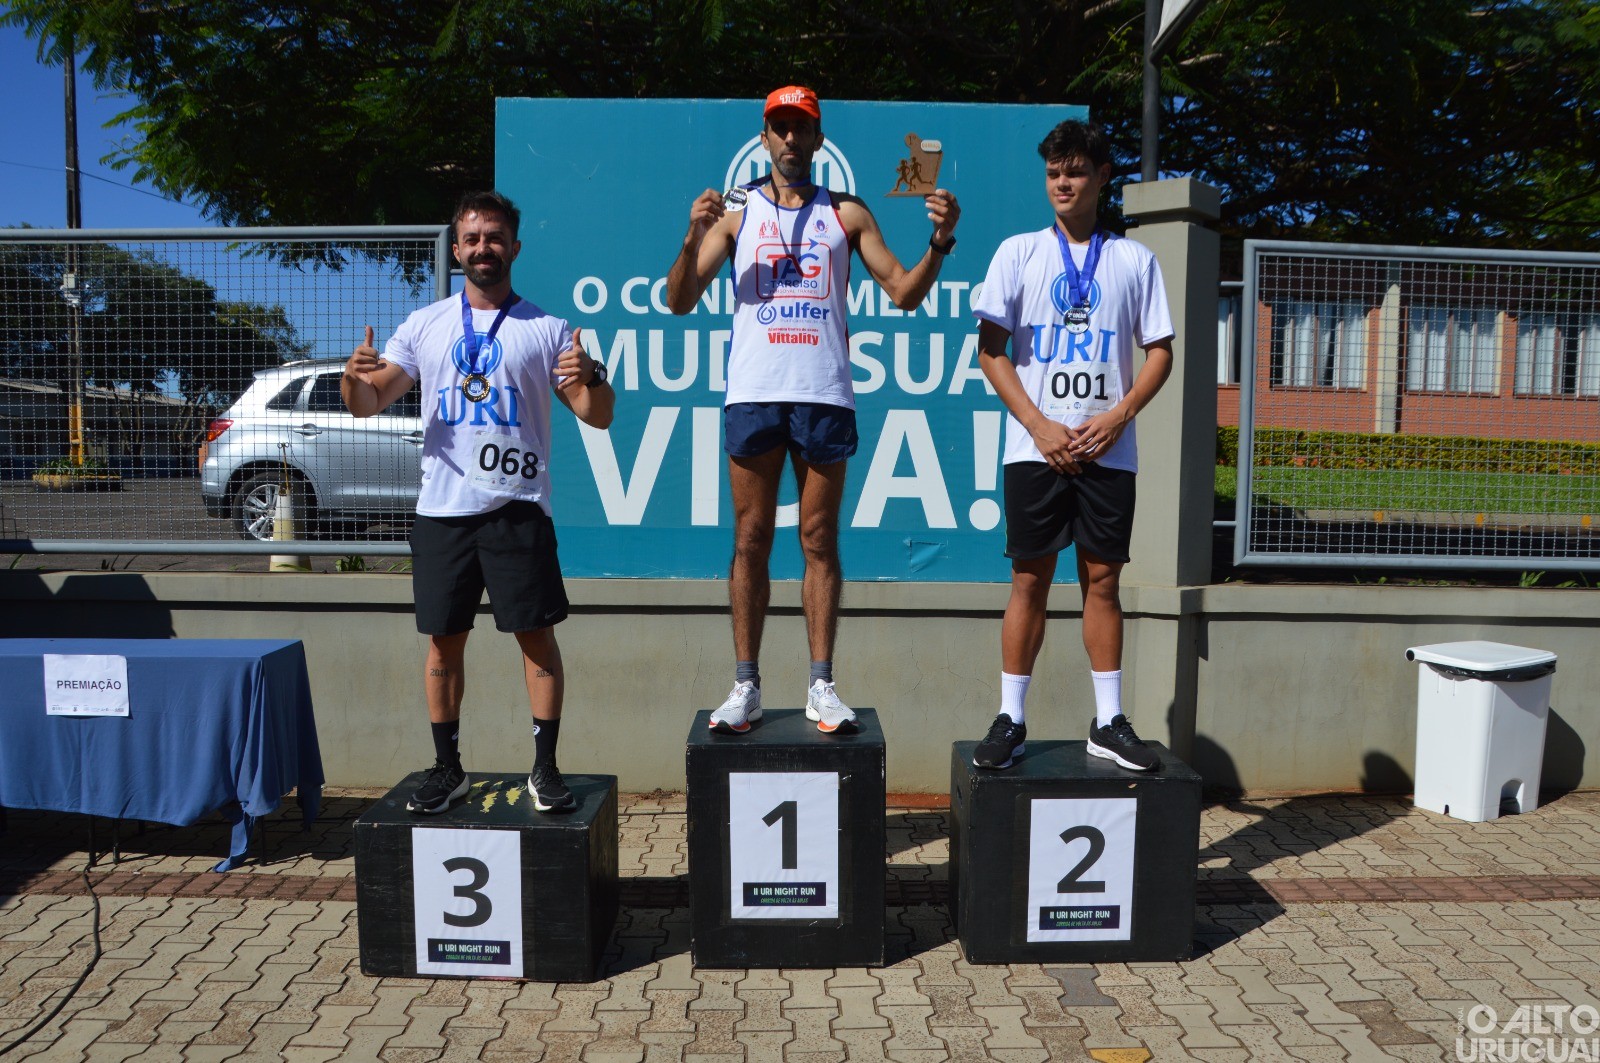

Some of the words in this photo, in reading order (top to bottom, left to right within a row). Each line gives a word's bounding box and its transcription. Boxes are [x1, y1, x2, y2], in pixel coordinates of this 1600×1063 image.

[766, 253, 822, 279] TAG
[573, 276, 608, 314] O
[770, 279, 818, 289] TARCISO
[780, 302, 830, 320] ulfer
[768, 332, 819, 346] Vittality
[1030, 323, 1116, 364] URI
[576, 328, 733, 393] MUD
[848, 331, 998, 395] SUA
[1051, 371, 1109, 400] 001
[438, 385, 522, 427] URI
[479, 443, 539, 479] 068
[575, 406, 1001, 530] VIA!
[56, 678, 122, 692] PREMIAÇÃO
[761, 801, 798, 869] 1
[1057, 825, 1105, 893] 2
[442, 856, 493, 927] 3
[760, 887, 773, 896] URI
[774, 887, 798, 896] NIGHT
[800, 887, 816, 896] RUN
[1056, 911, 1068, 919] URI
[1069, 910, 1093, 919] NIGHT
[1095, 910, 1110, 918] RUN
[444, 944, 457, 952] URI
[458, 944, 483, 953] NIGHT
[484, 945, 500, 954] RUN
